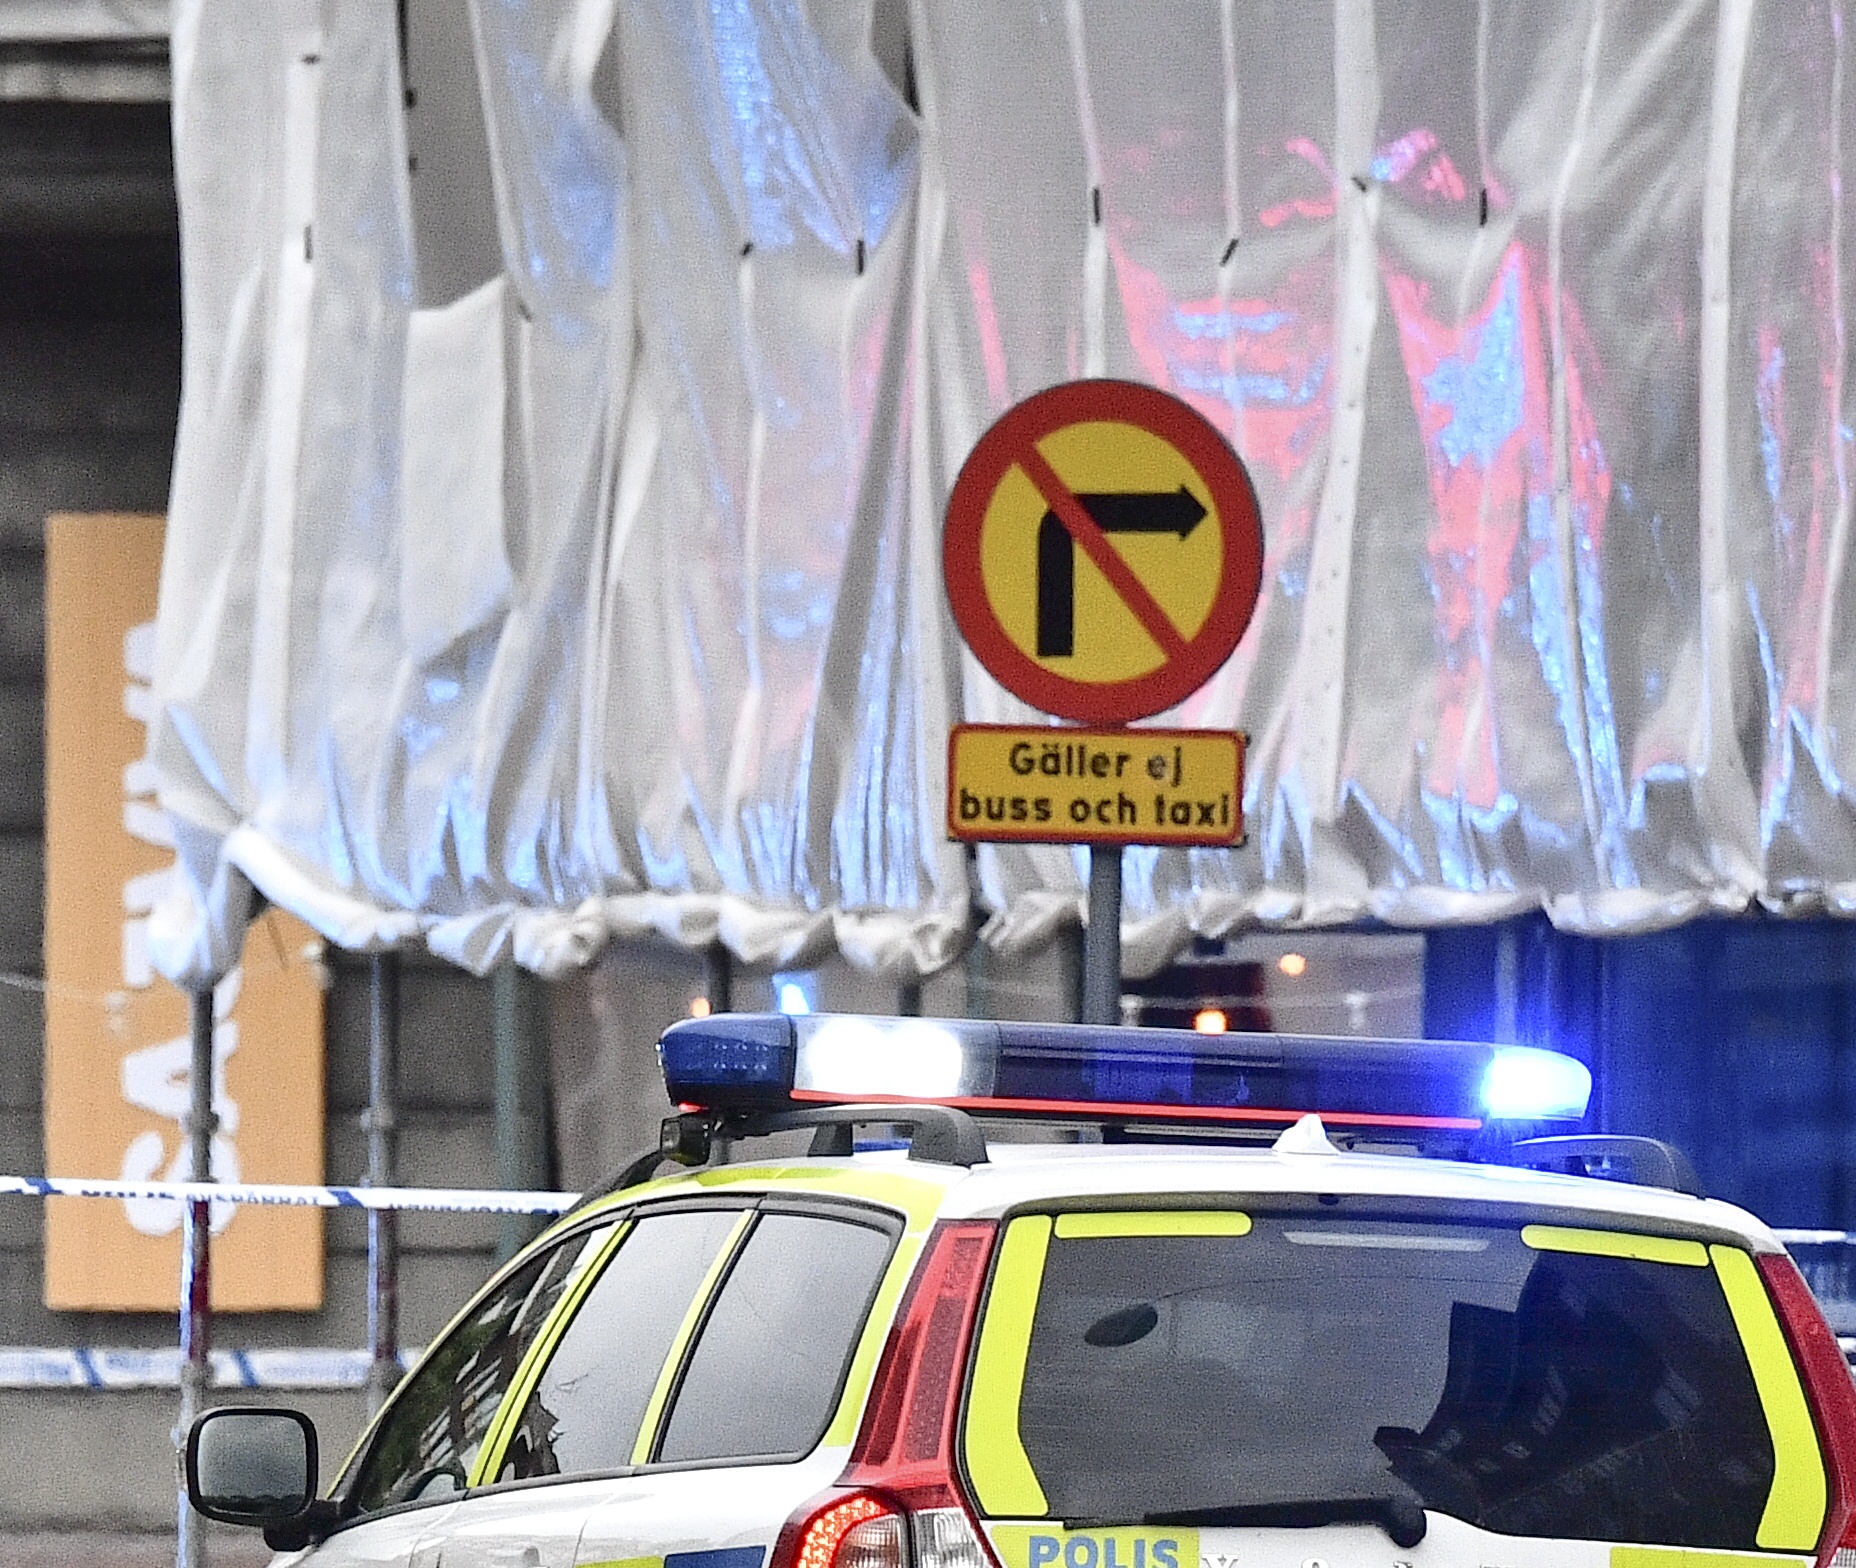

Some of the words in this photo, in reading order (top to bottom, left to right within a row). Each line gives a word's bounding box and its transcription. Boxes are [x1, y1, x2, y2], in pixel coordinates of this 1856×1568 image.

[1009, 742, 1131, 780] Gäller
[1147, 746, 1183, 787] ej
[960, 788, 1052, 823] buss
[1070, 792, 1137, 826] och
[1155, 794, 1230, 828] taxi
